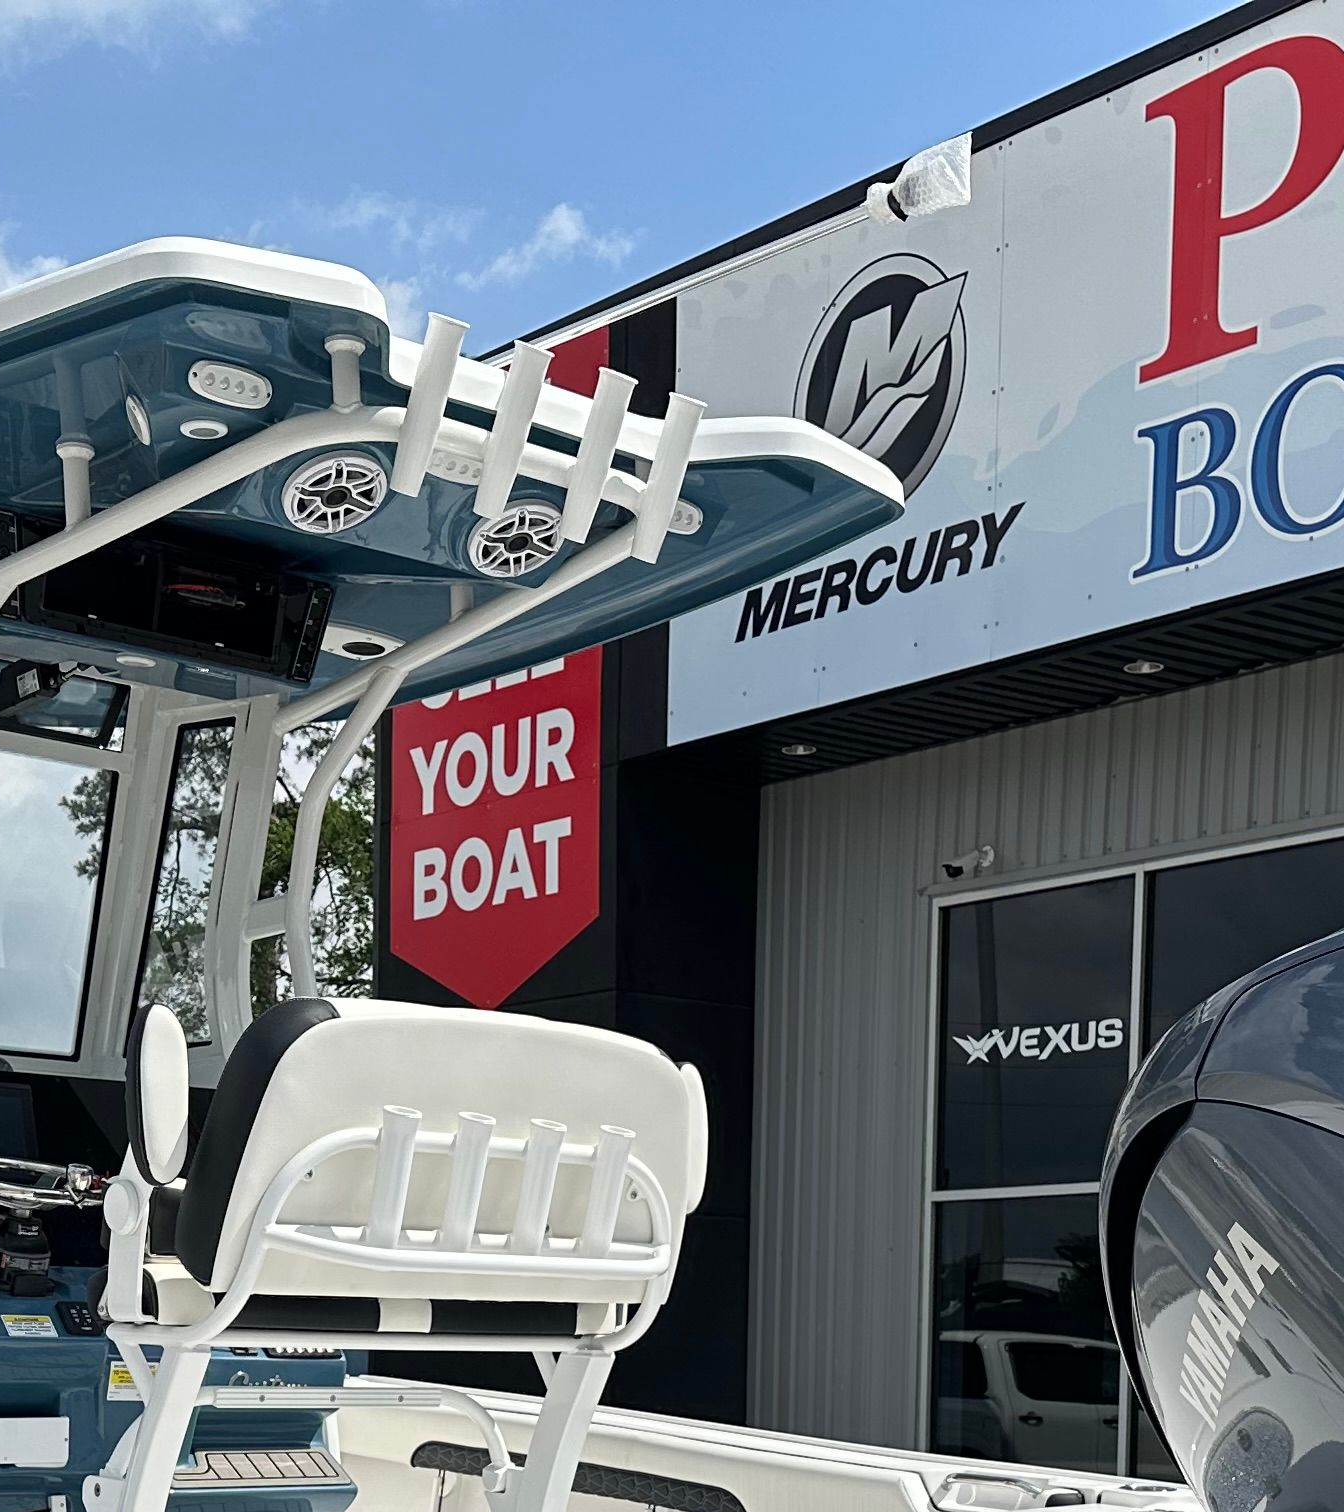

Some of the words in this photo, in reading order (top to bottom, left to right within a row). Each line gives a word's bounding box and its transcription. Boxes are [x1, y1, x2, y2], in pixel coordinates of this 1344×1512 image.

[734, 501, 1026, 644] MERCURY
[409, 706, 576, 816] YOUR
[412, 815, 573, 922] BOAT
[990, 1017, 1124, 1061] VEXUS
[1179, 1221, 1280, 1432] YAMAHA
